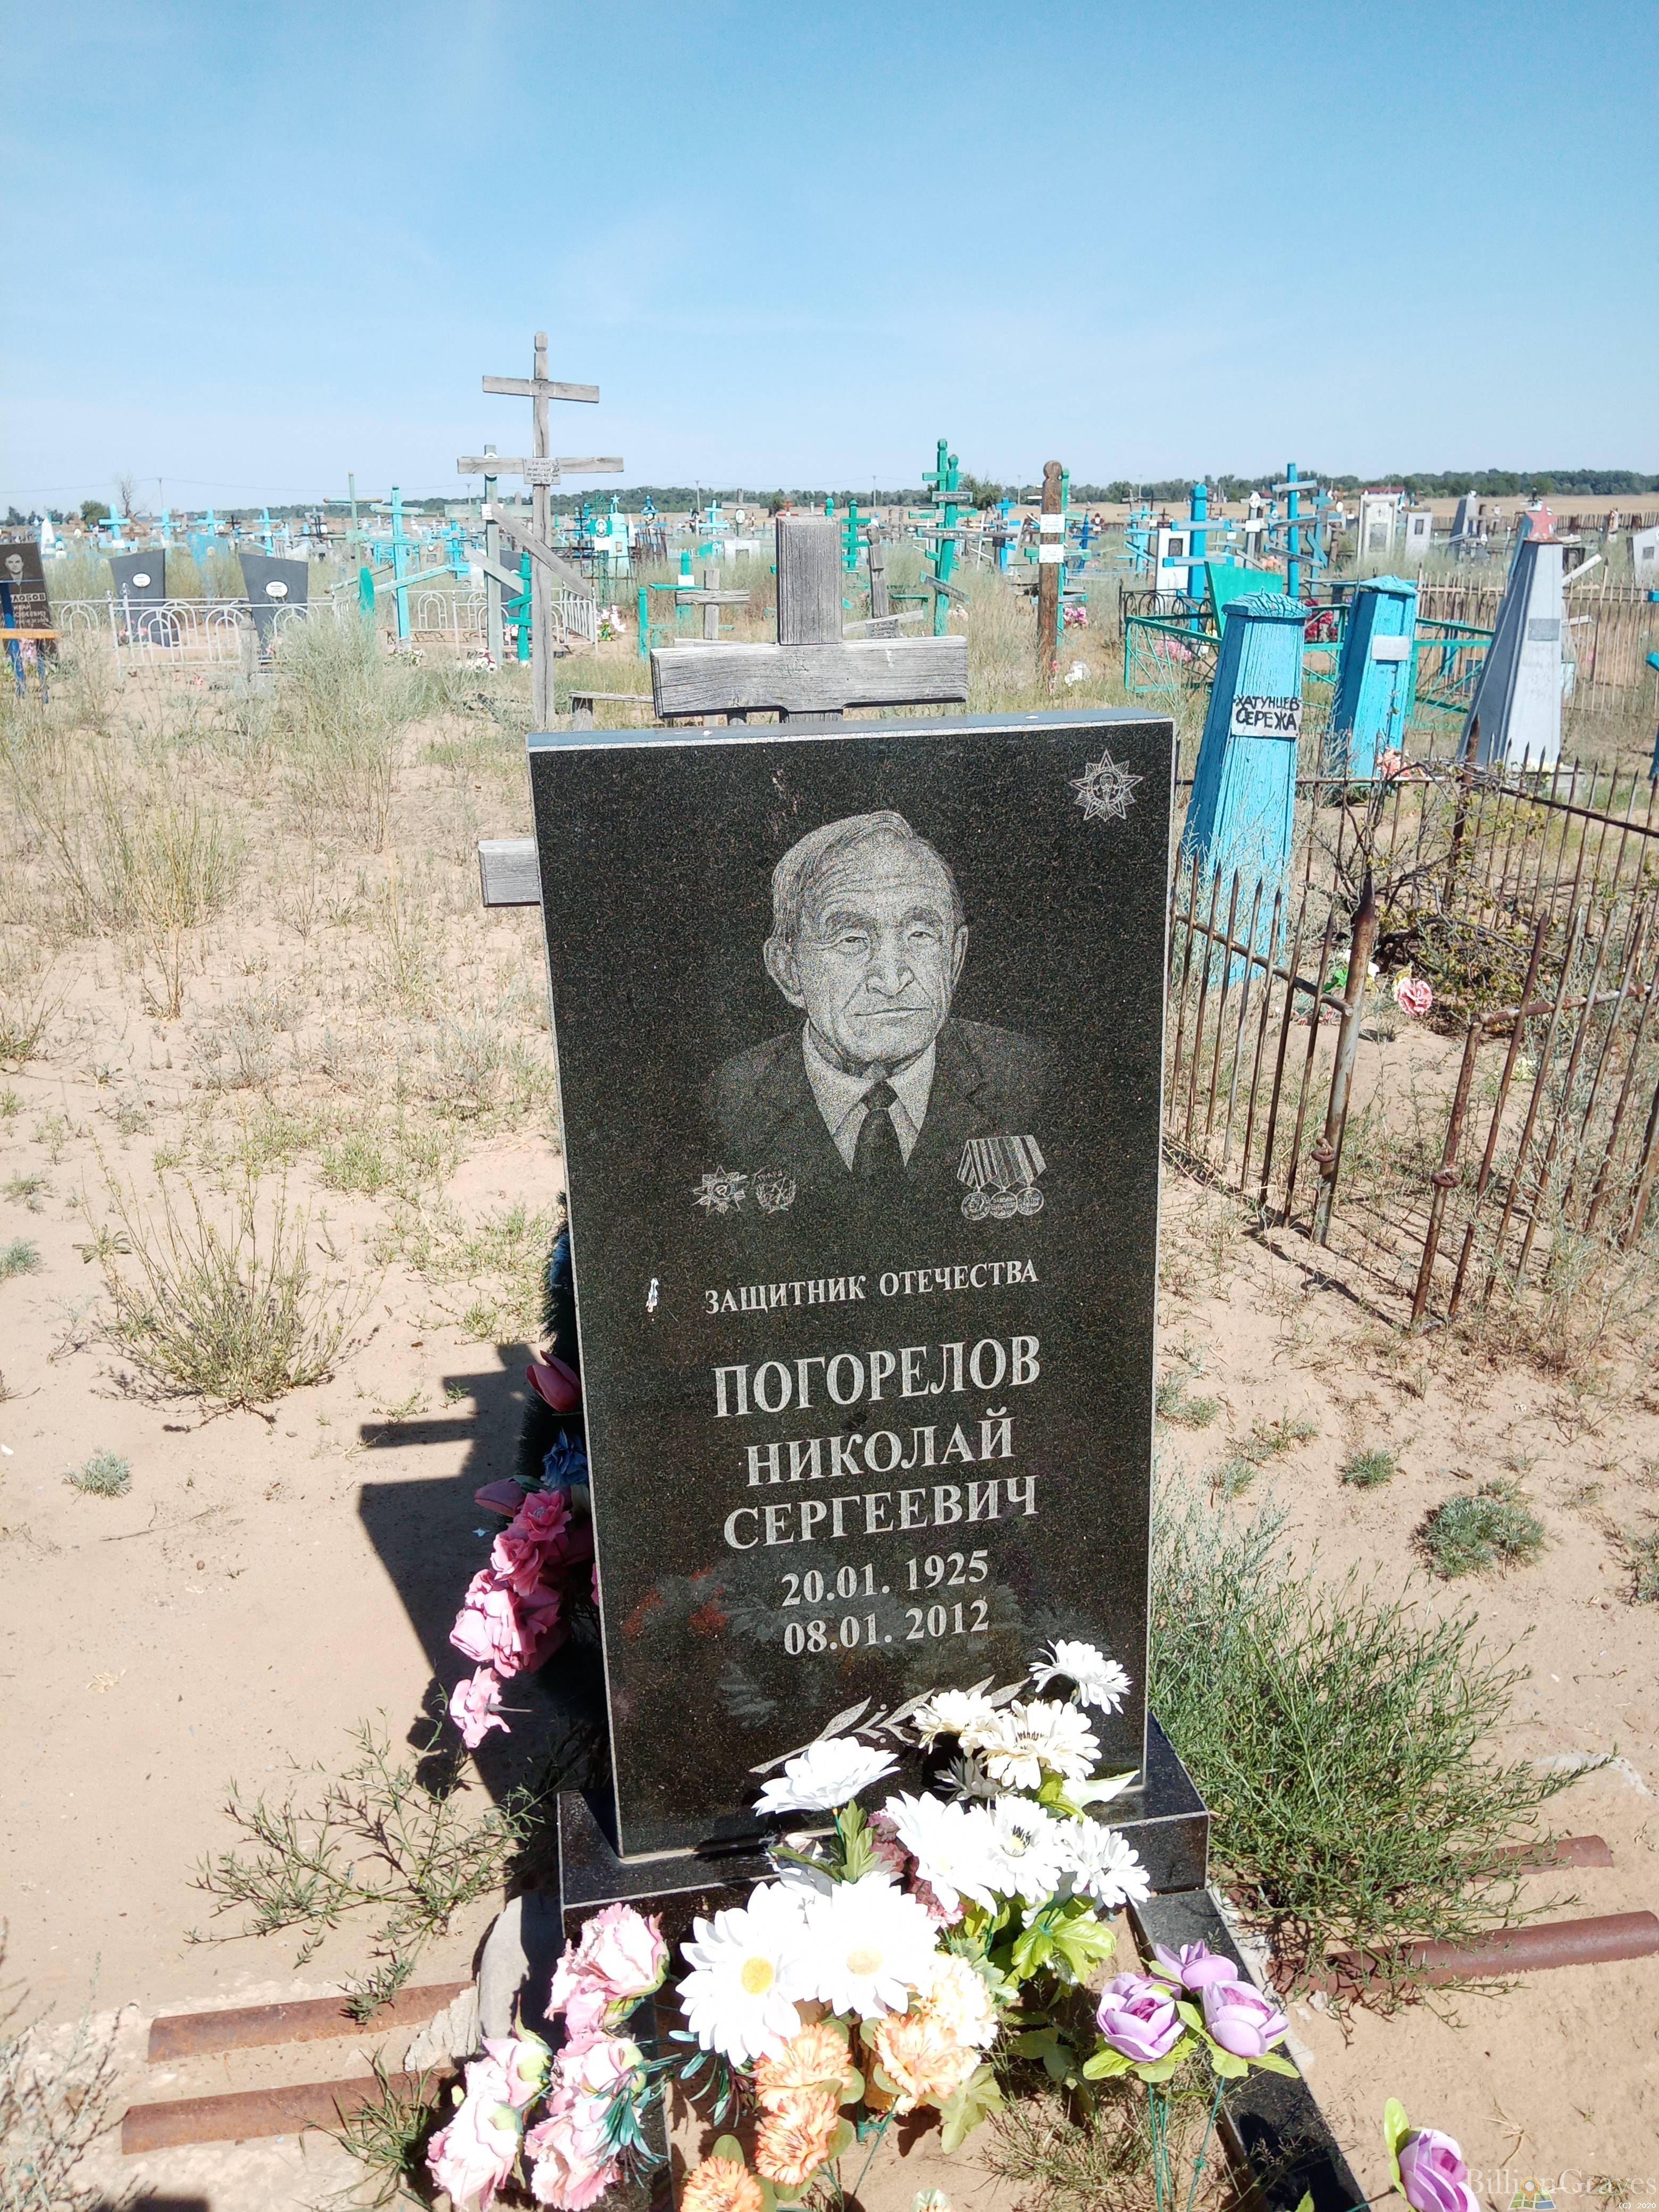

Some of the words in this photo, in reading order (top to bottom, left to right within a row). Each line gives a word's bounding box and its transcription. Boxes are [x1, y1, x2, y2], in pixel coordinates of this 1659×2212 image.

[1235, 694, 1300, 711] ХАТУНЦЕВ
[1236, 707, 1297, 731] СЕРЕЖА
[705, 1275, 866, 1314] ЗАЩИТНИК
[879, 1259, 1038, 1297] ОТЕЧЕСТВА
[712, 1335, 1040, 1418] ПОГОРЕЛОВ
[745, 1406, 1016, 1487] НИКОЛАЙ
[724, 1475, 1040, 1549] СЕРГЕЕВИЧ
[782, 1564, 890, 1607] 20.01.
[906, 1549, 989, 1591] 1925
[784, 1613, 892, 1655] 08.01.
[906, 1600, 990, 1640] 2012
